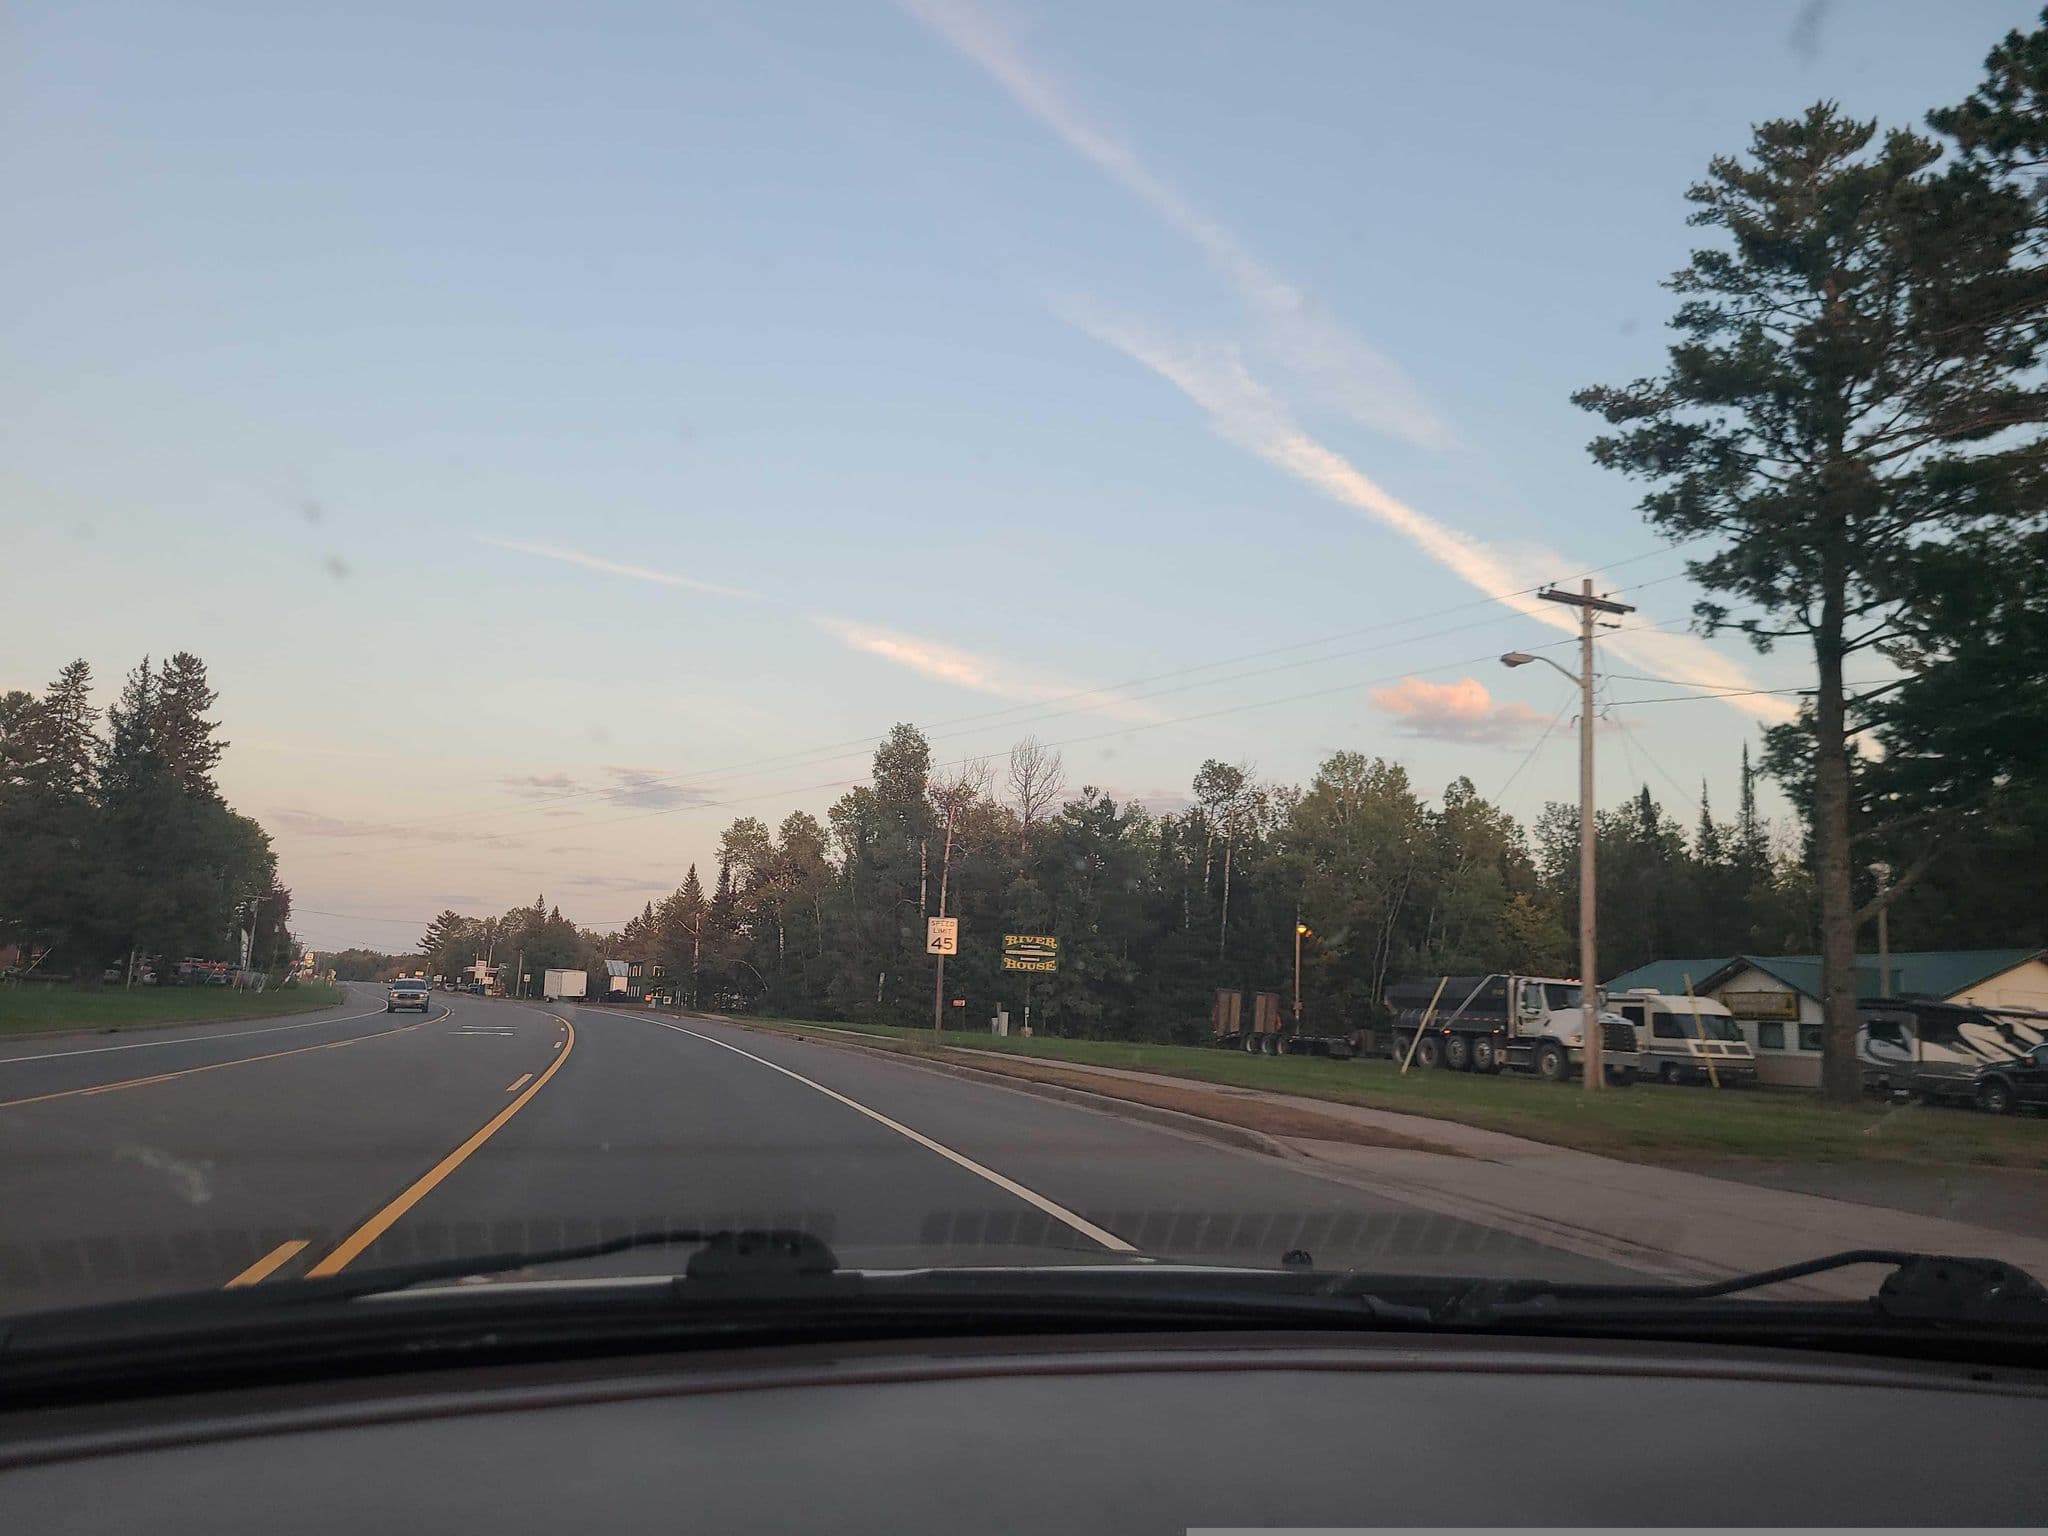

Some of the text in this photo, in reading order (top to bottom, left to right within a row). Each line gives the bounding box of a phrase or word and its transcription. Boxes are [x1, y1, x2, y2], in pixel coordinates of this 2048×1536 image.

[931, 937, 953, 950] 45
[1005, 935, 1057, 949] RIVER
[1004, 957, 1056, 971] HOUSE
